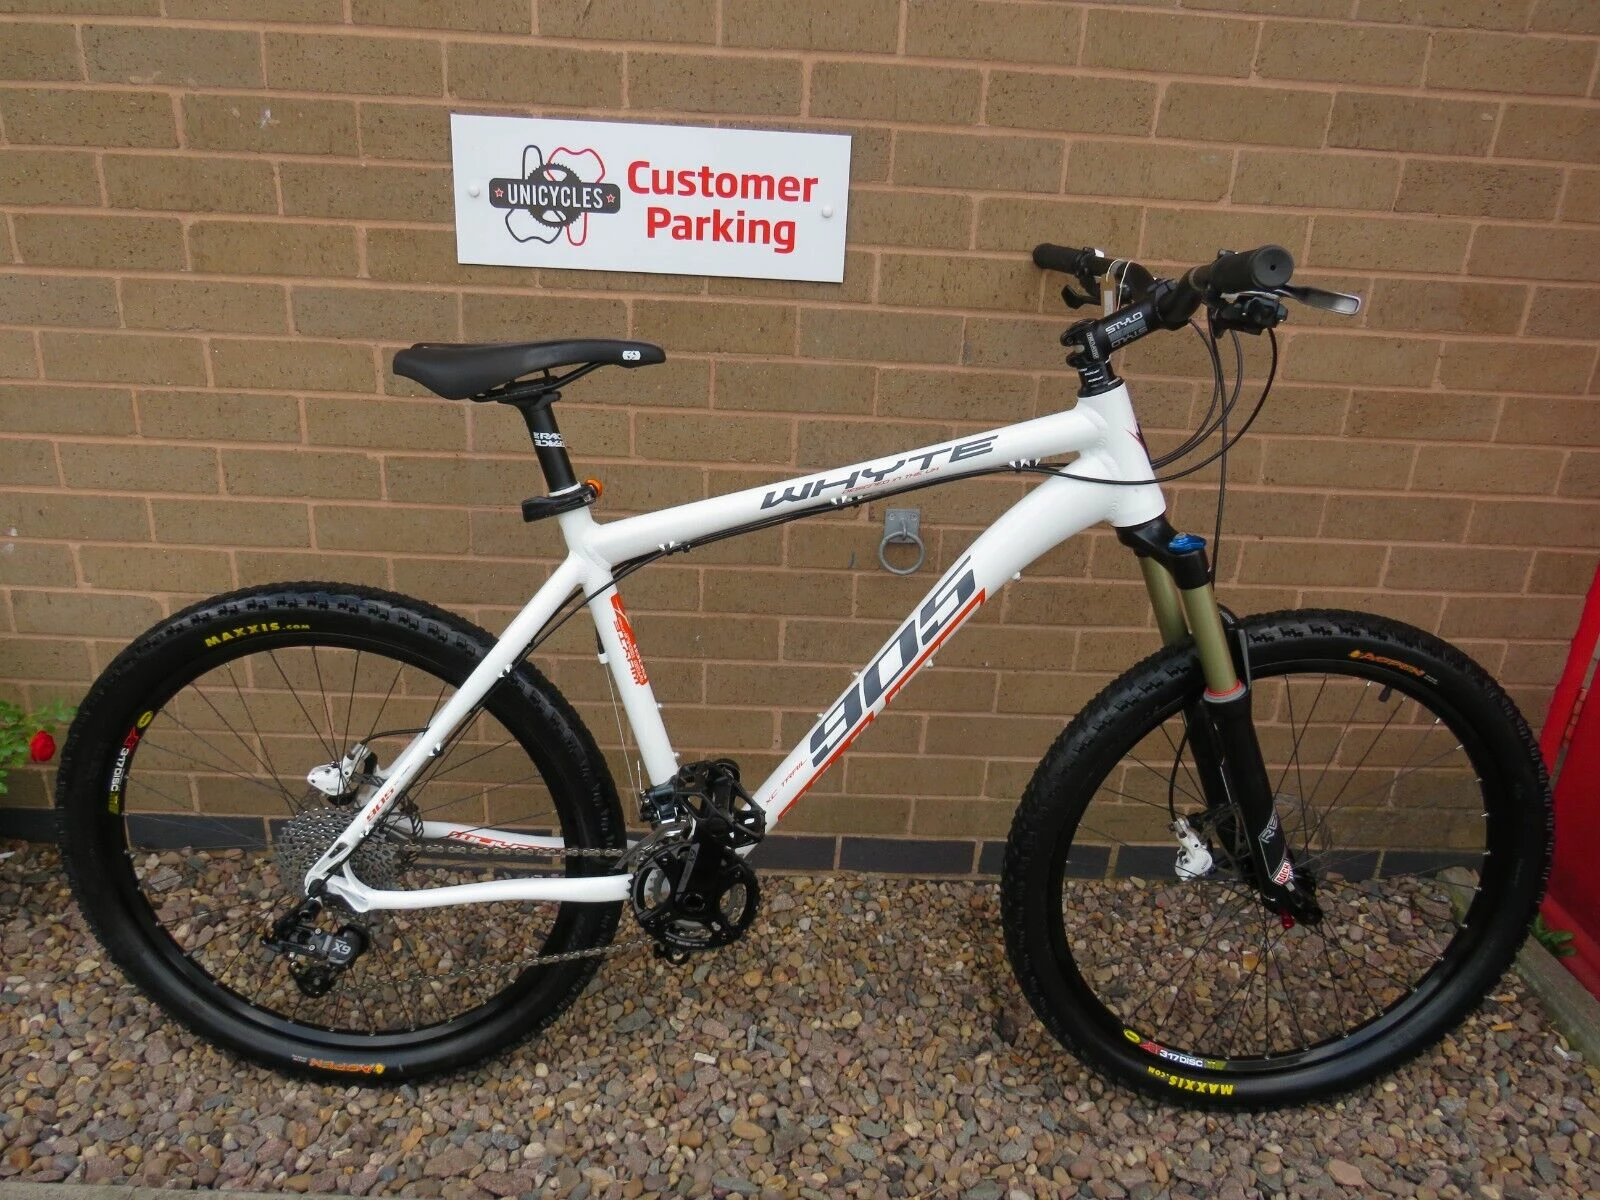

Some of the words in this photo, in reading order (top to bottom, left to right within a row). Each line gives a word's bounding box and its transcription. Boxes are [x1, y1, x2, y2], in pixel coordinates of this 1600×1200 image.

[507, 183, 604, 210] UNICYCLES
[627, 160, 819, 203] Customer
[646, 206, 797, 255] Parking
[1105, 310, 1144, 335] STYLO
[759, 434, 1000, 511] WHYTE
[809, 554, 976, 768] 905
[781, 758, 808, 788] TRAIL
[366, 786, 396, 823] 905
[1275, 862, 1291, 885] ROCK
